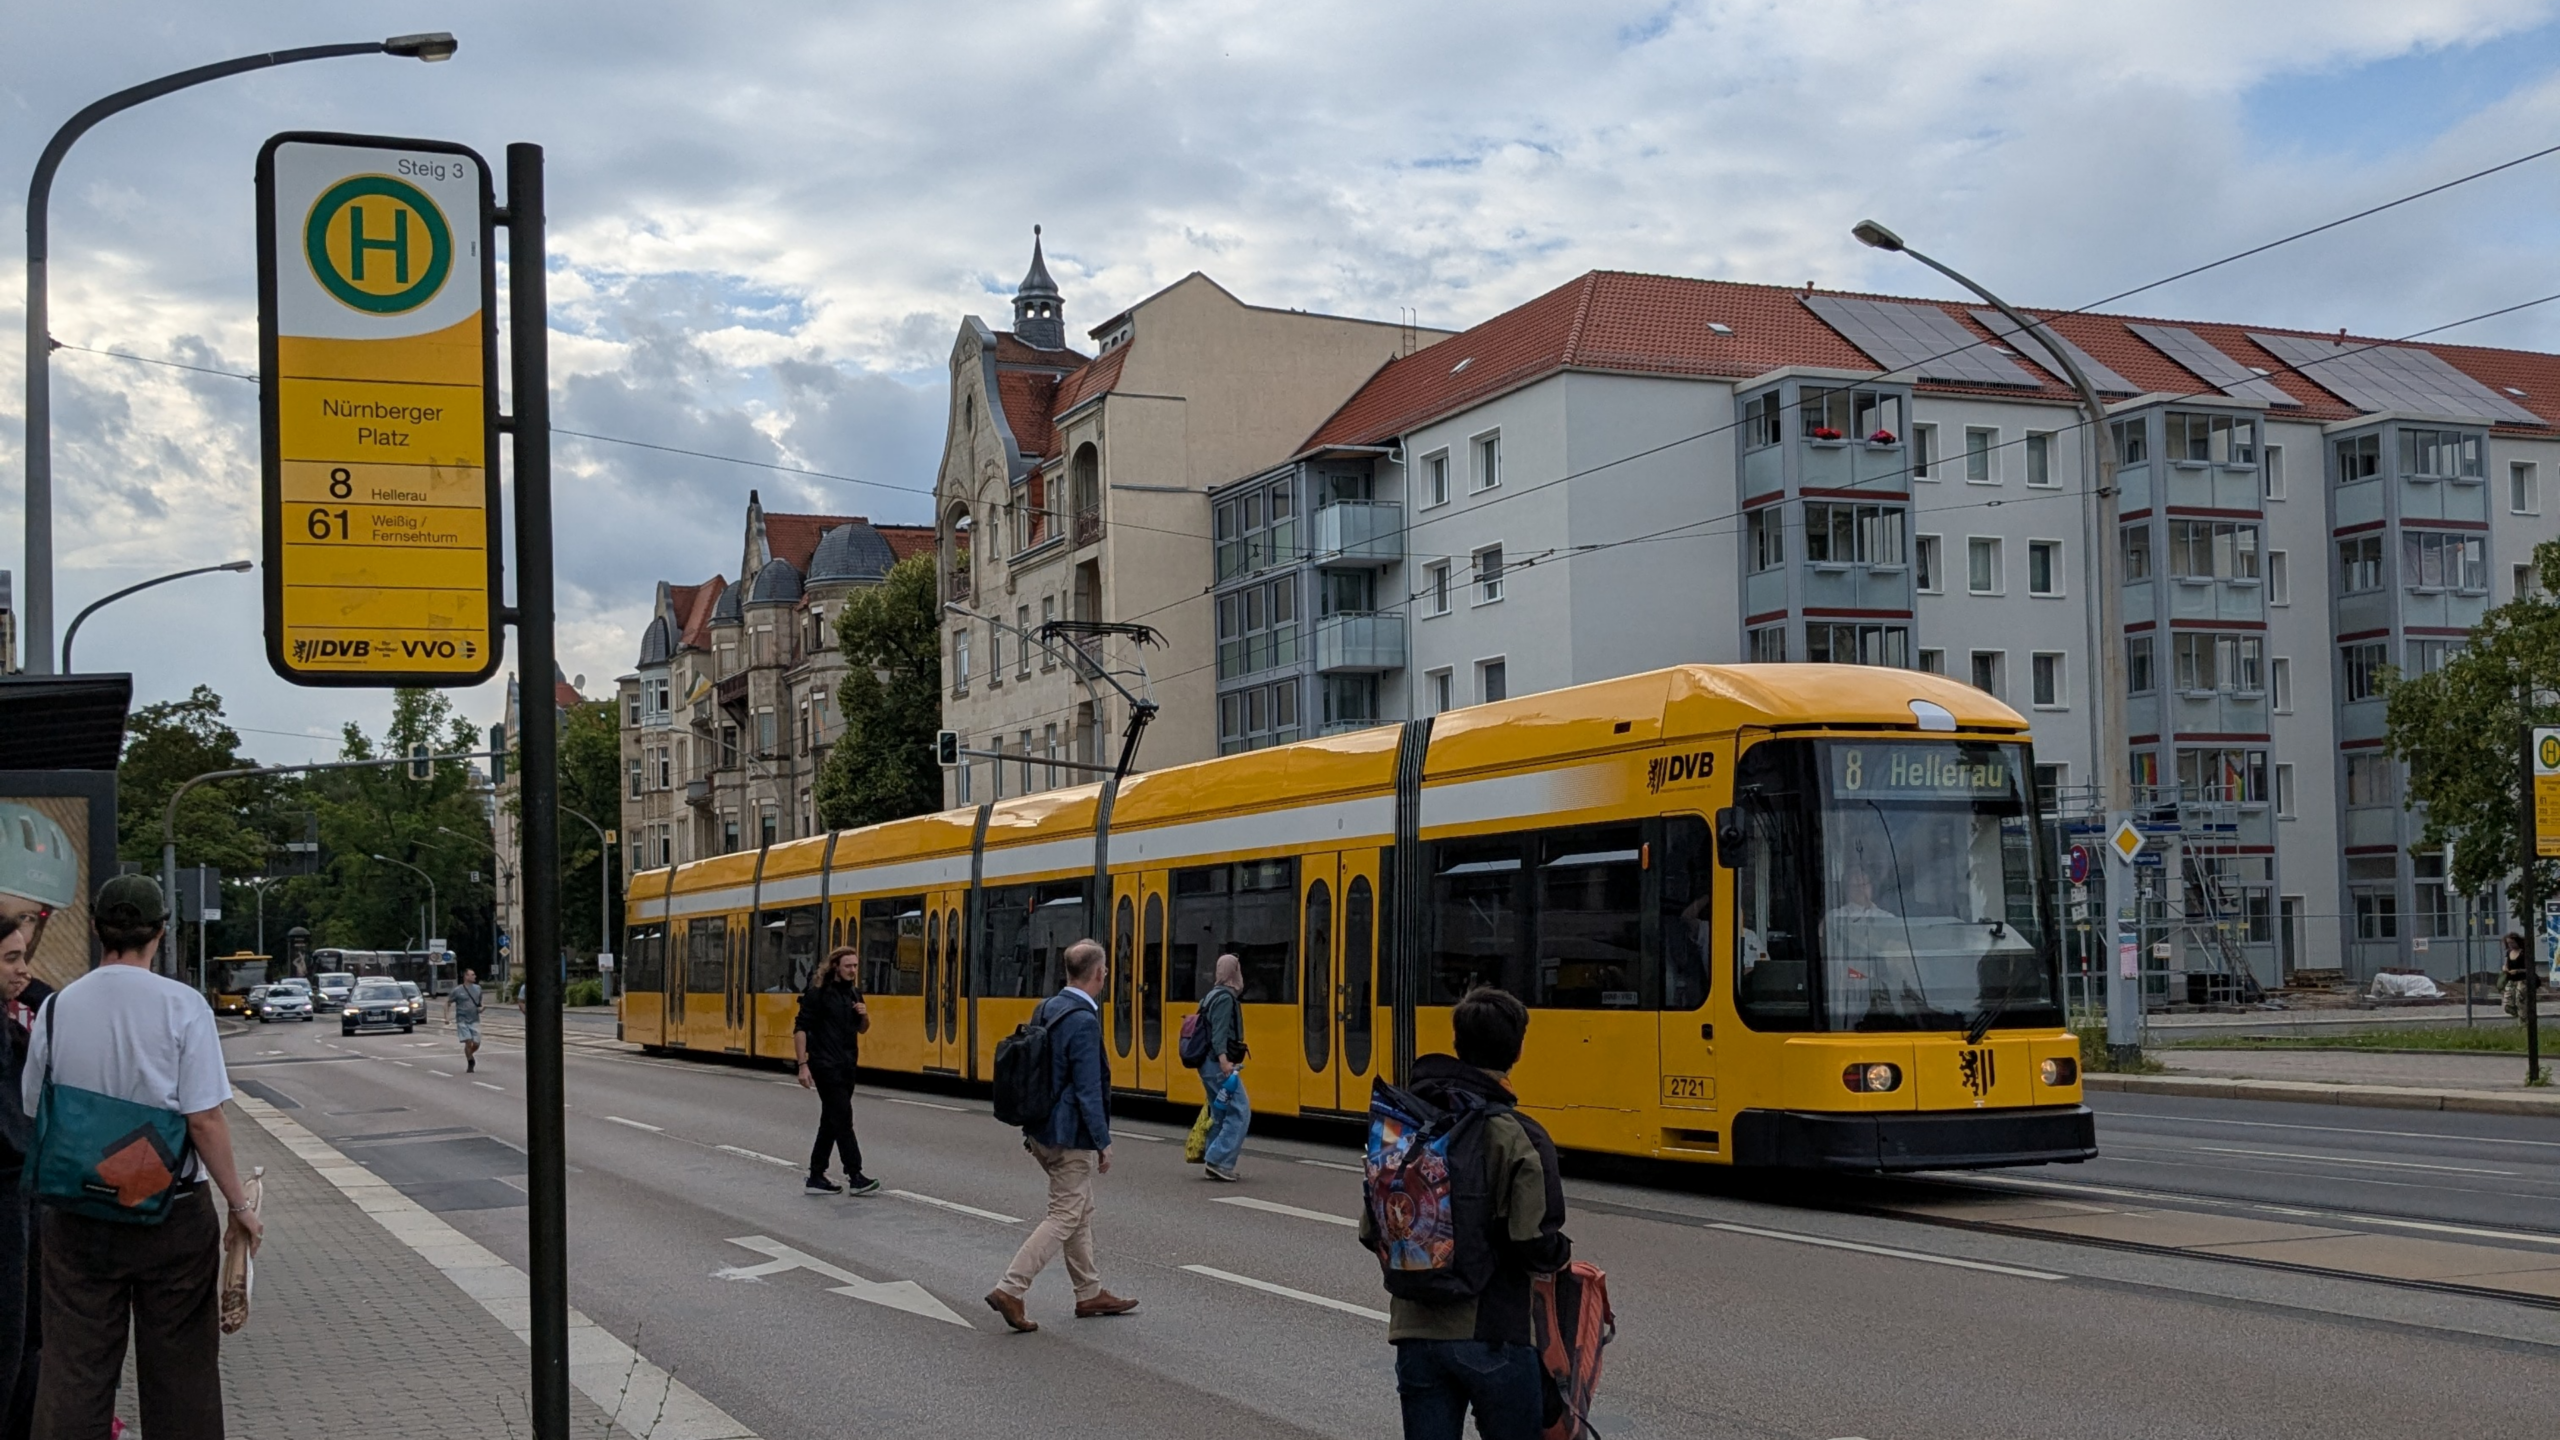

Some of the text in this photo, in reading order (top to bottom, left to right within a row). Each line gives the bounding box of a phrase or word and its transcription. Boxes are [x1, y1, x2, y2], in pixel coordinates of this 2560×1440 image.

[398, 159, 464, 181] Steig 3
[350, 206, 409, 284] H
[323, 399, 443, 425] Nürnberger
[358, 428, 410, 447] Platz
[329, 468, 427, 502] 8 Hellerau
[307, 508, 350, 540] 61
[372, 515, 418, 529] Weißig
[372, 529, 458, 543] Fernsehturm
[320, 640, 370, 657] DVB
[401, 640, 456, 658] VVO
[1668, 752, 1714, 781] DVB
[1845, 750, 2004, 790] 8 Hellerau
[1671, 1078, 1704, 1097] 2721
